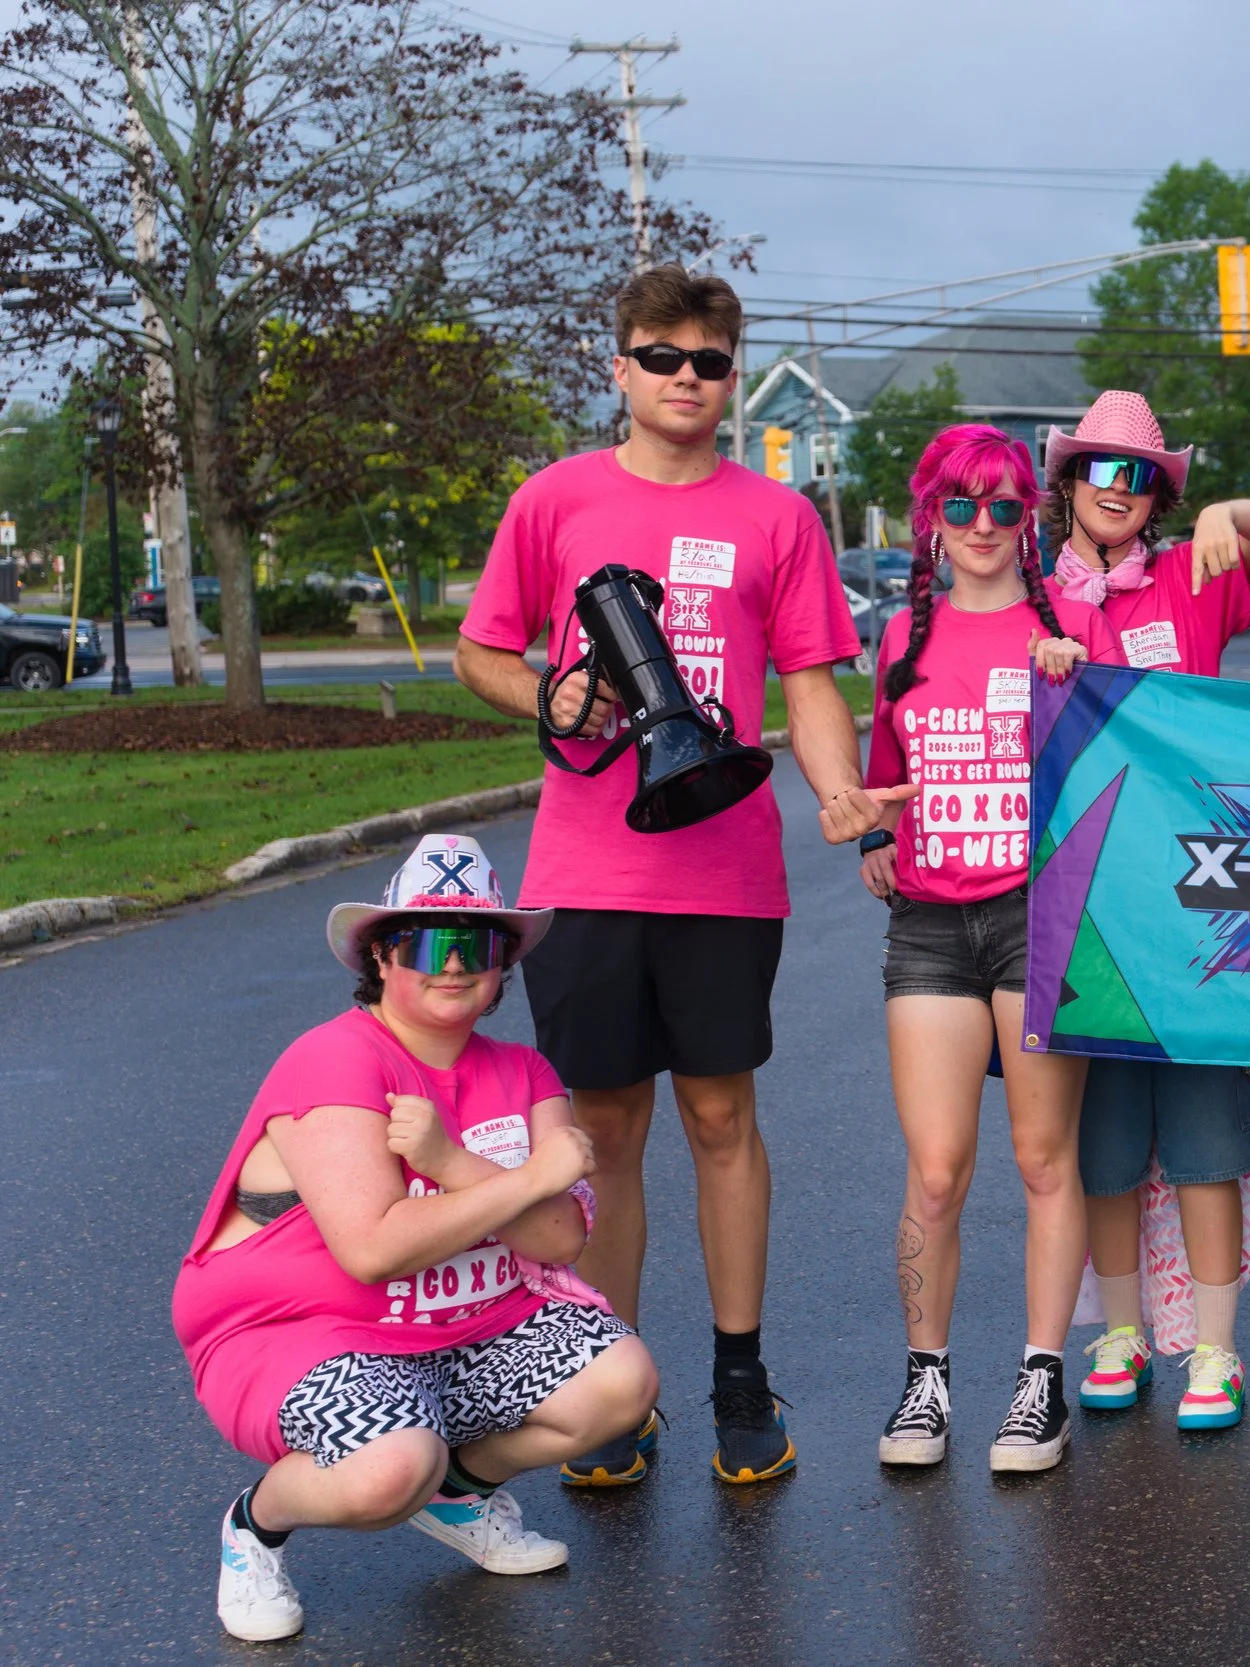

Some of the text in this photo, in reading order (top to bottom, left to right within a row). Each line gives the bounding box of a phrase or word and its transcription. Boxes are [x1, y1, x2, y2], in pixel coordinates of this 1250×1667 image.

[695, 542, 714, 550] NAME
[681, 548, 716, 562] Ryan
[673, 603, 709, 617] StFX
[1129, 631, 1138, 639] MY
[1140, 625, 1156, 634] NAME
[673, 634, 726, 654] ROWDY
[1130, 633, 1169, 649] Sheridan
[997, 680, 1029, 690] SKYE
[904, 707, 984, 733] O-CREW
[993, 731, 1019, 743] StFX
[928, 742, 981, 752] 2026-2027
[924, 762, 1030, 780] LET'S GET ROWD
[929, 794, 962, 822] GO
[974, 793, 989, 822] X
[927, 833, 1029, 868] O-WEE
[422, 850, 478, 897] X
[471, 1127, 481, 1137] MY
[484, 1121, 505, 1133] NAME
[423, 1266, 459, 1300] GO
[471, 1259, 485, 1294] X
